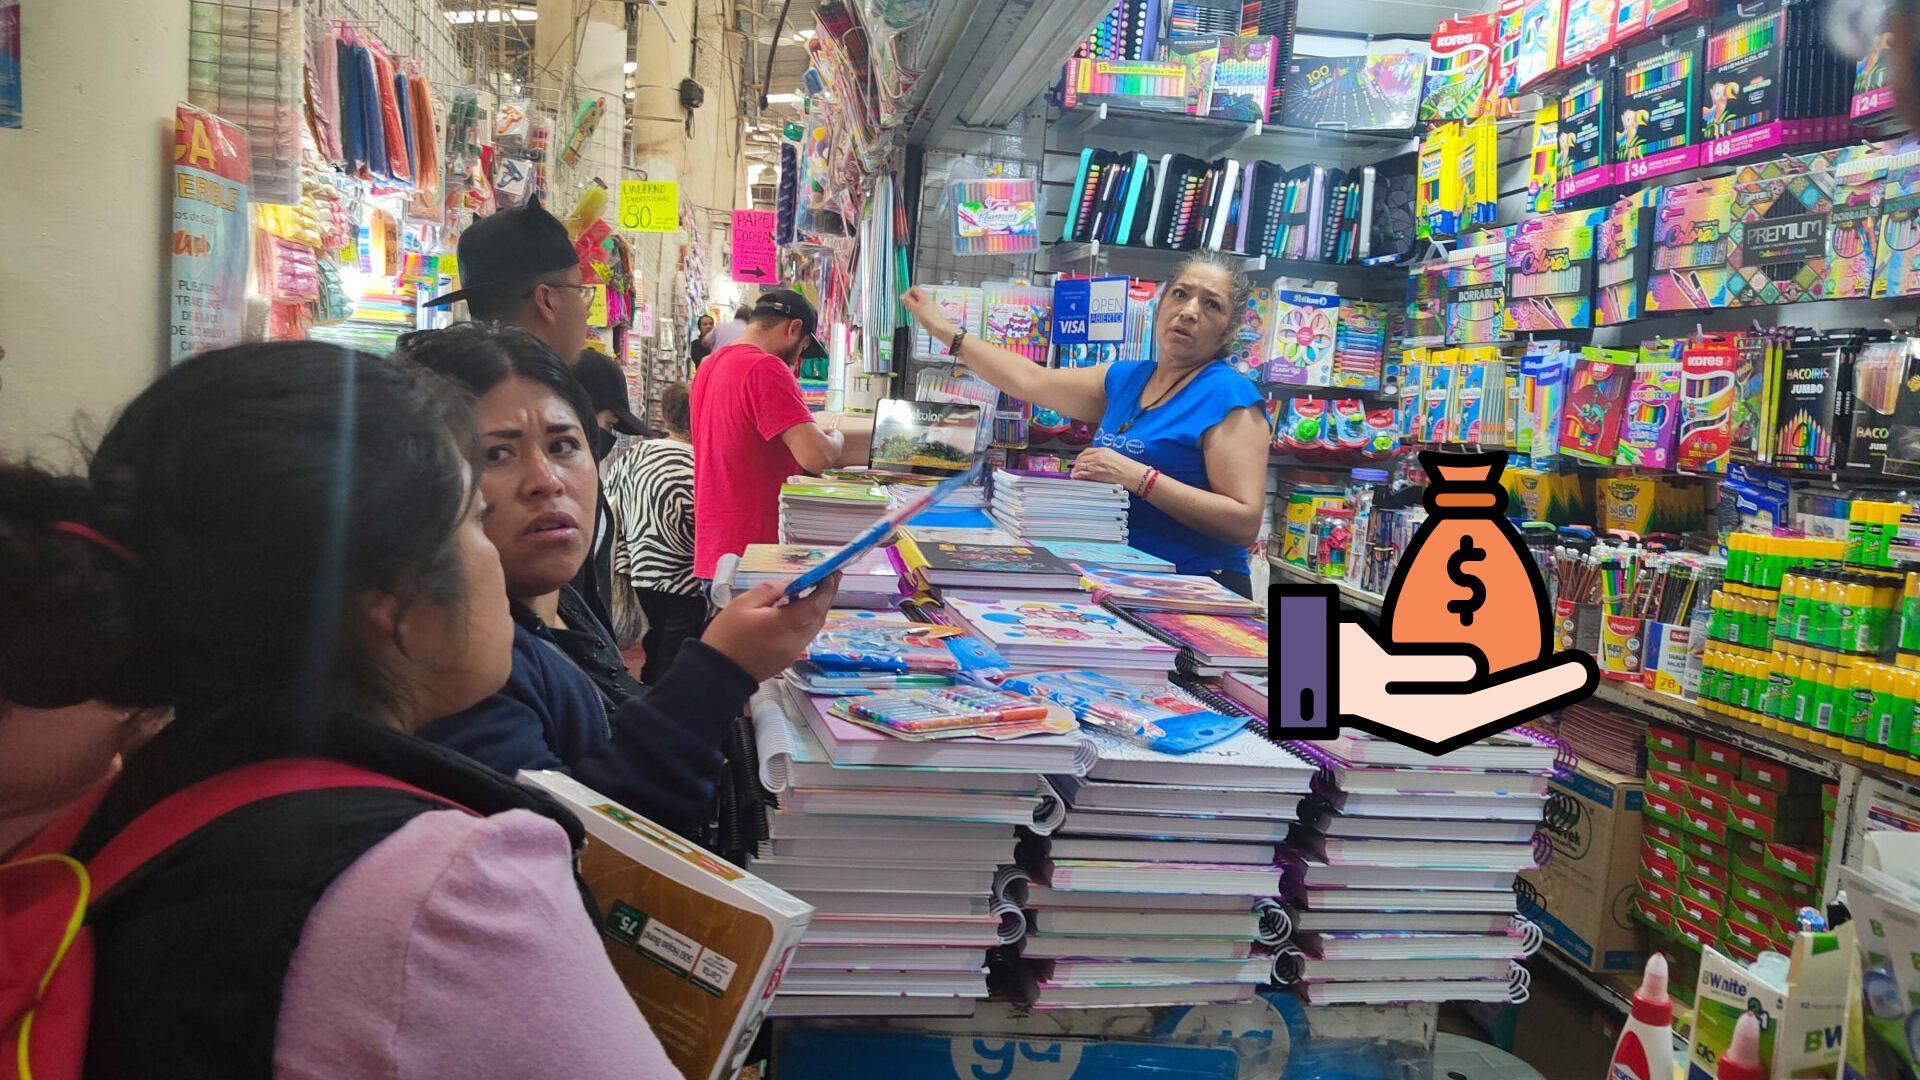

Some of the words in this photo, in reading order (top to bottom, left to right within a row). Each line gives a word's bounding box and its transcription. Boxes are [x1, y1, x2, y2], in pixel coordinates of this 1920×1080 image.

[1718, 50, 1769, 73] PRISMACOLOR
[1306, 65, 1330, 83] 100
[1633, 81, 1682, 100] PRISMACOLOR
[1860, 94, 1878, 111] 24
[1714, 140, 1730, 157] 48
[1631, 161, 1648, 177] 36
[1565, 180, 1576, 194] 36
[623, 204, 652, 229] 80
[1747, 219, 1823, 245] PREMIUM
[1458, 287, 1504, 302] BORRABLES
[1091, 298, 1123, 313] OPEN
[1091, 313, 1123, 323] ABIERTO
[1059, 320, 1086, 334] VISA
[1687, 356, 1724, 368] Kores
[1790, 384, 1824, 394] JUMBO
[621, 916, 638, 936] 75
[661, 942, 680, 957] Hojas
[679, 951, 694, 964] 500
[702, 967, 722, 983] Carta
